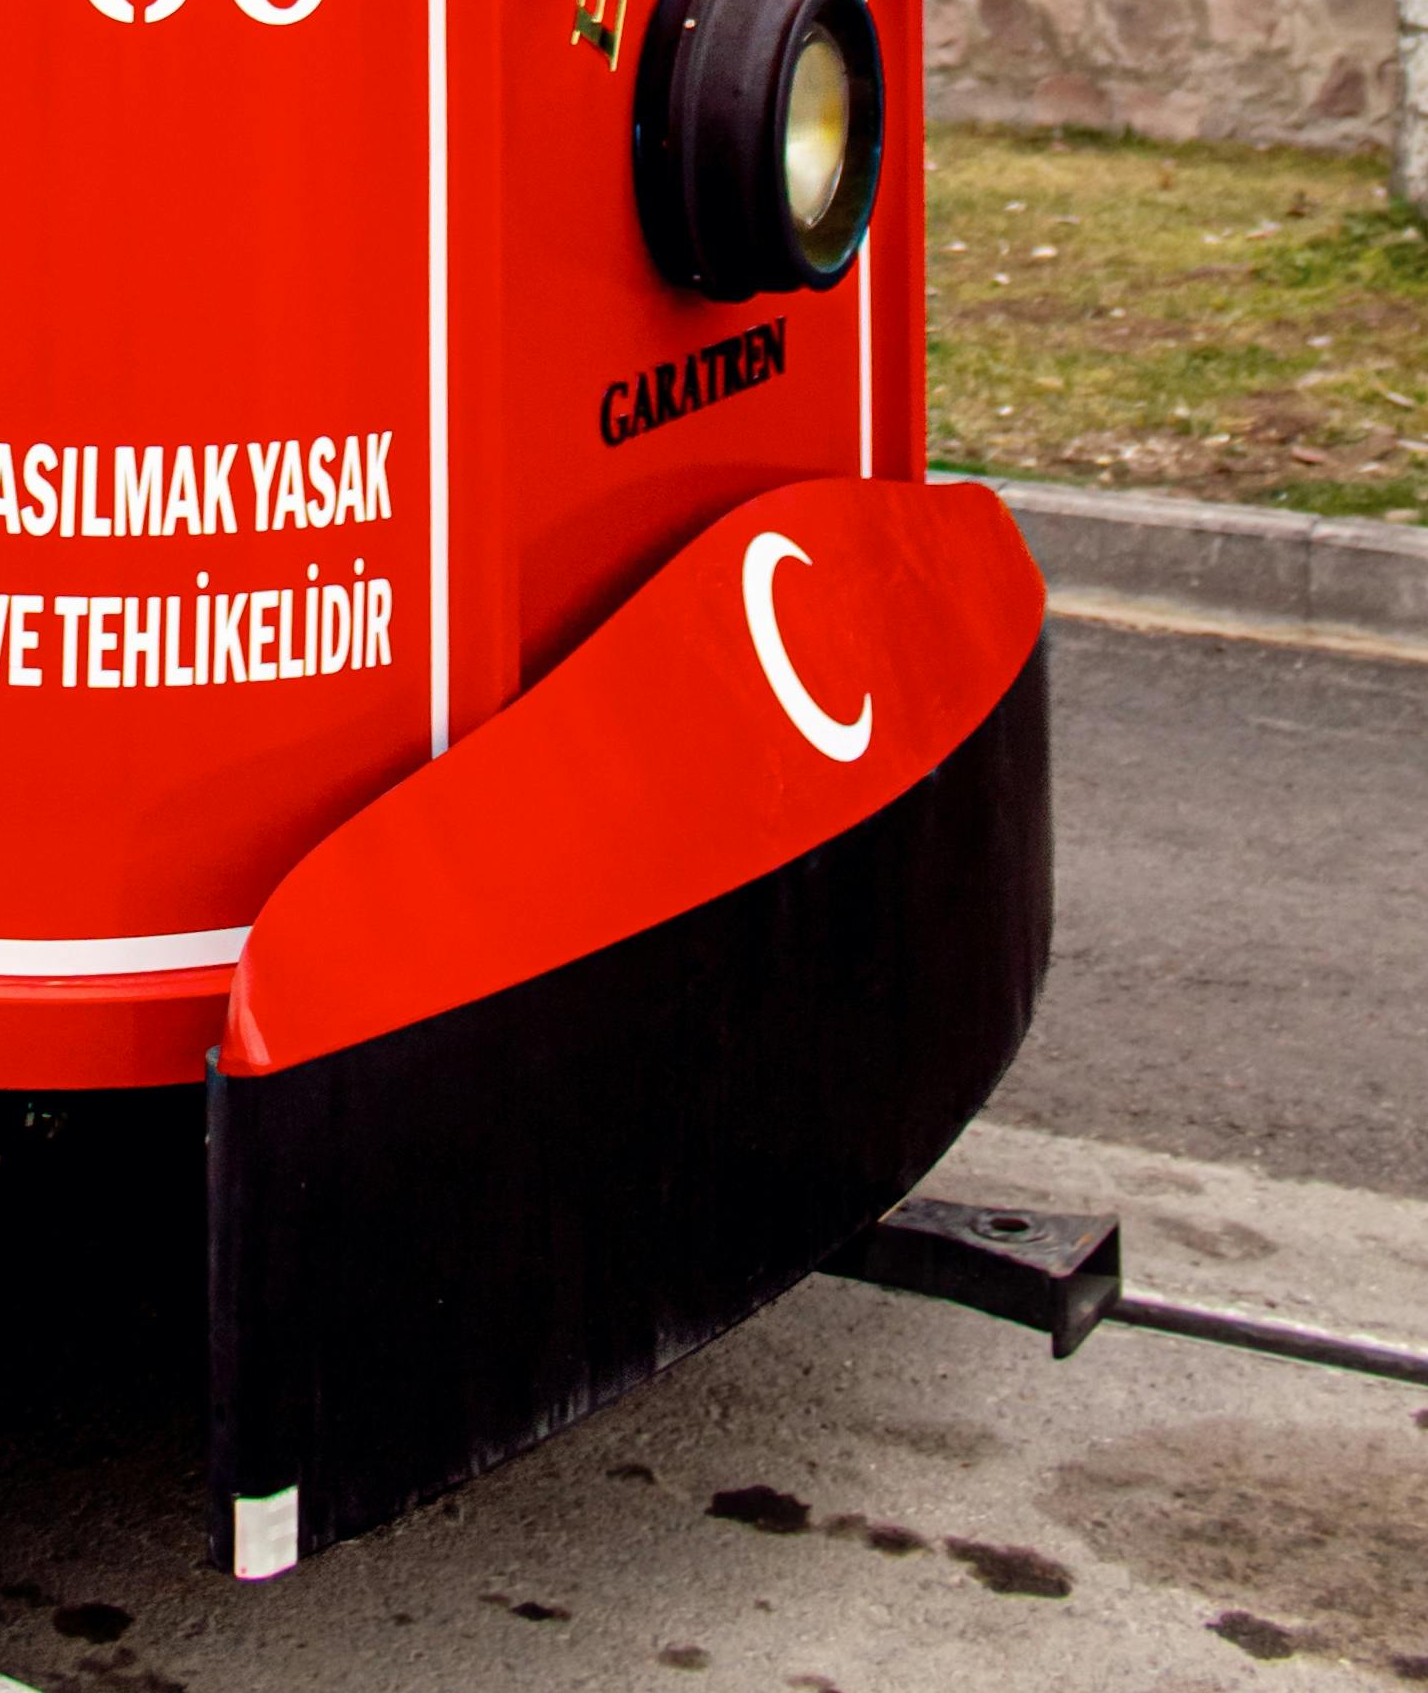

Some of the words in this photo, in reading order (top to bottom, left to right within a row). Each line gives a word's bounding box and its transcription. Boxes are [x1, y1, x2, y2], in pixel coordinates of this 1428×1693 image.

[599, 315, 787, 448] GARATREN
[247, 430, 393, 531] YASAK
[54, 558, 392, 688] TEHLİKELİDİR
